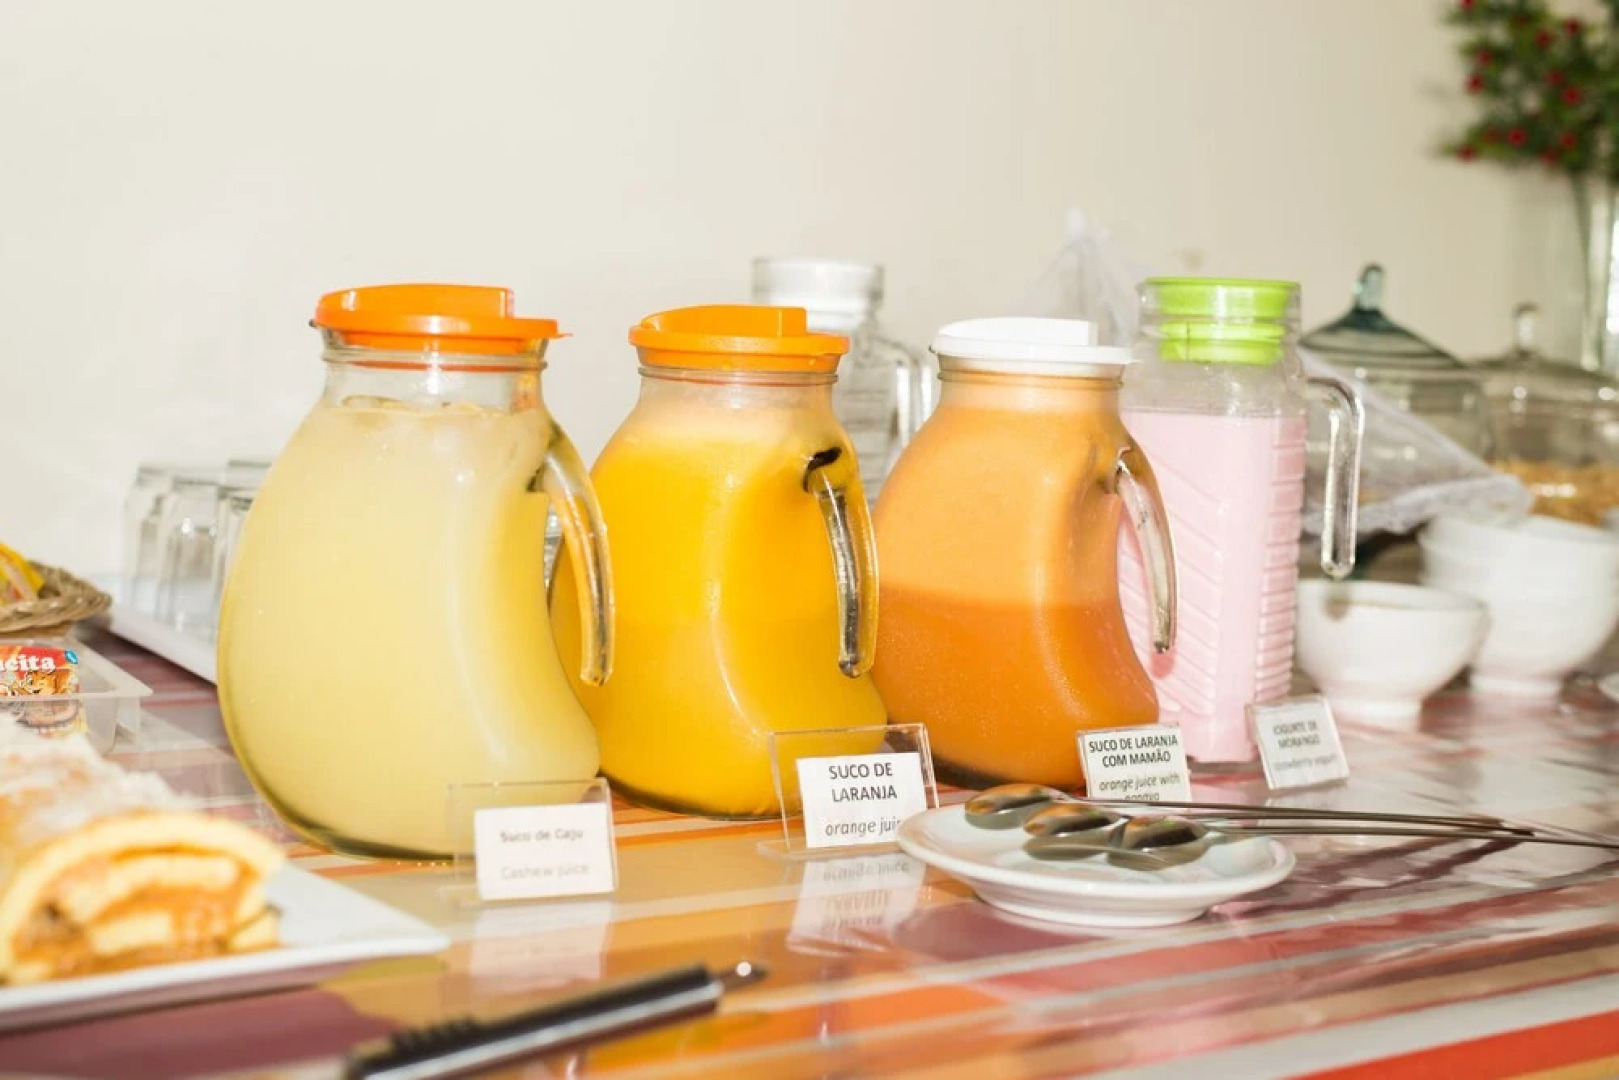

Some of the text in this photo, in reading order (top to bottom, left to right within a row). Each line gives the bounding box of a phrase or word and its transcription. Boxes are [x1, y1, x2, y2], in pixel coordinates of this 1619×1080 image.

[1089, 735, 1179, 753] SUCO DE LARANJA
[1102, 748, 1171, 768] COM MAMÃO
[828, 762, 893, 779] SUCO DE
[1099, 771, 1180, 792] orange juice with
[832, 785, 897, 802] LARANJA
[825, 816, 901, 837] orange jui
[500, 829, 531, 843] Suco
[536, 829, 550, 841] de
